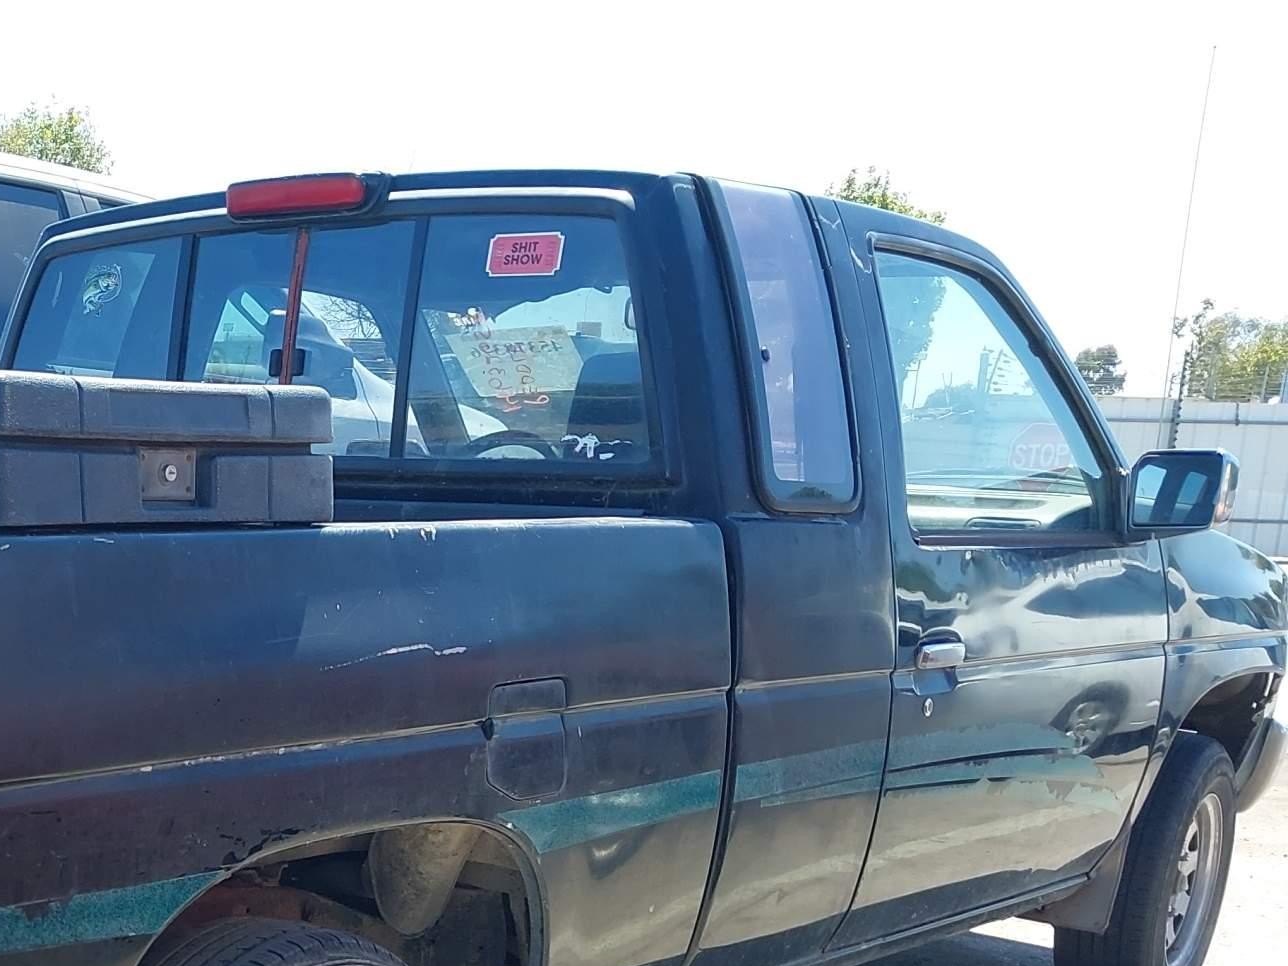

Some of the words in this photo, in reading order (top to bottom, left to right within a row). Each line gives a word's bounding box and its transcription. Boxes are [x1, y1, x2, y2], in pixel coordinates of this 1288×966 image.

[511, 241, 539, 253] SHIT
[503, 253, 543, 265] SHOW
[1012, 442, 1070, 468] STOP
